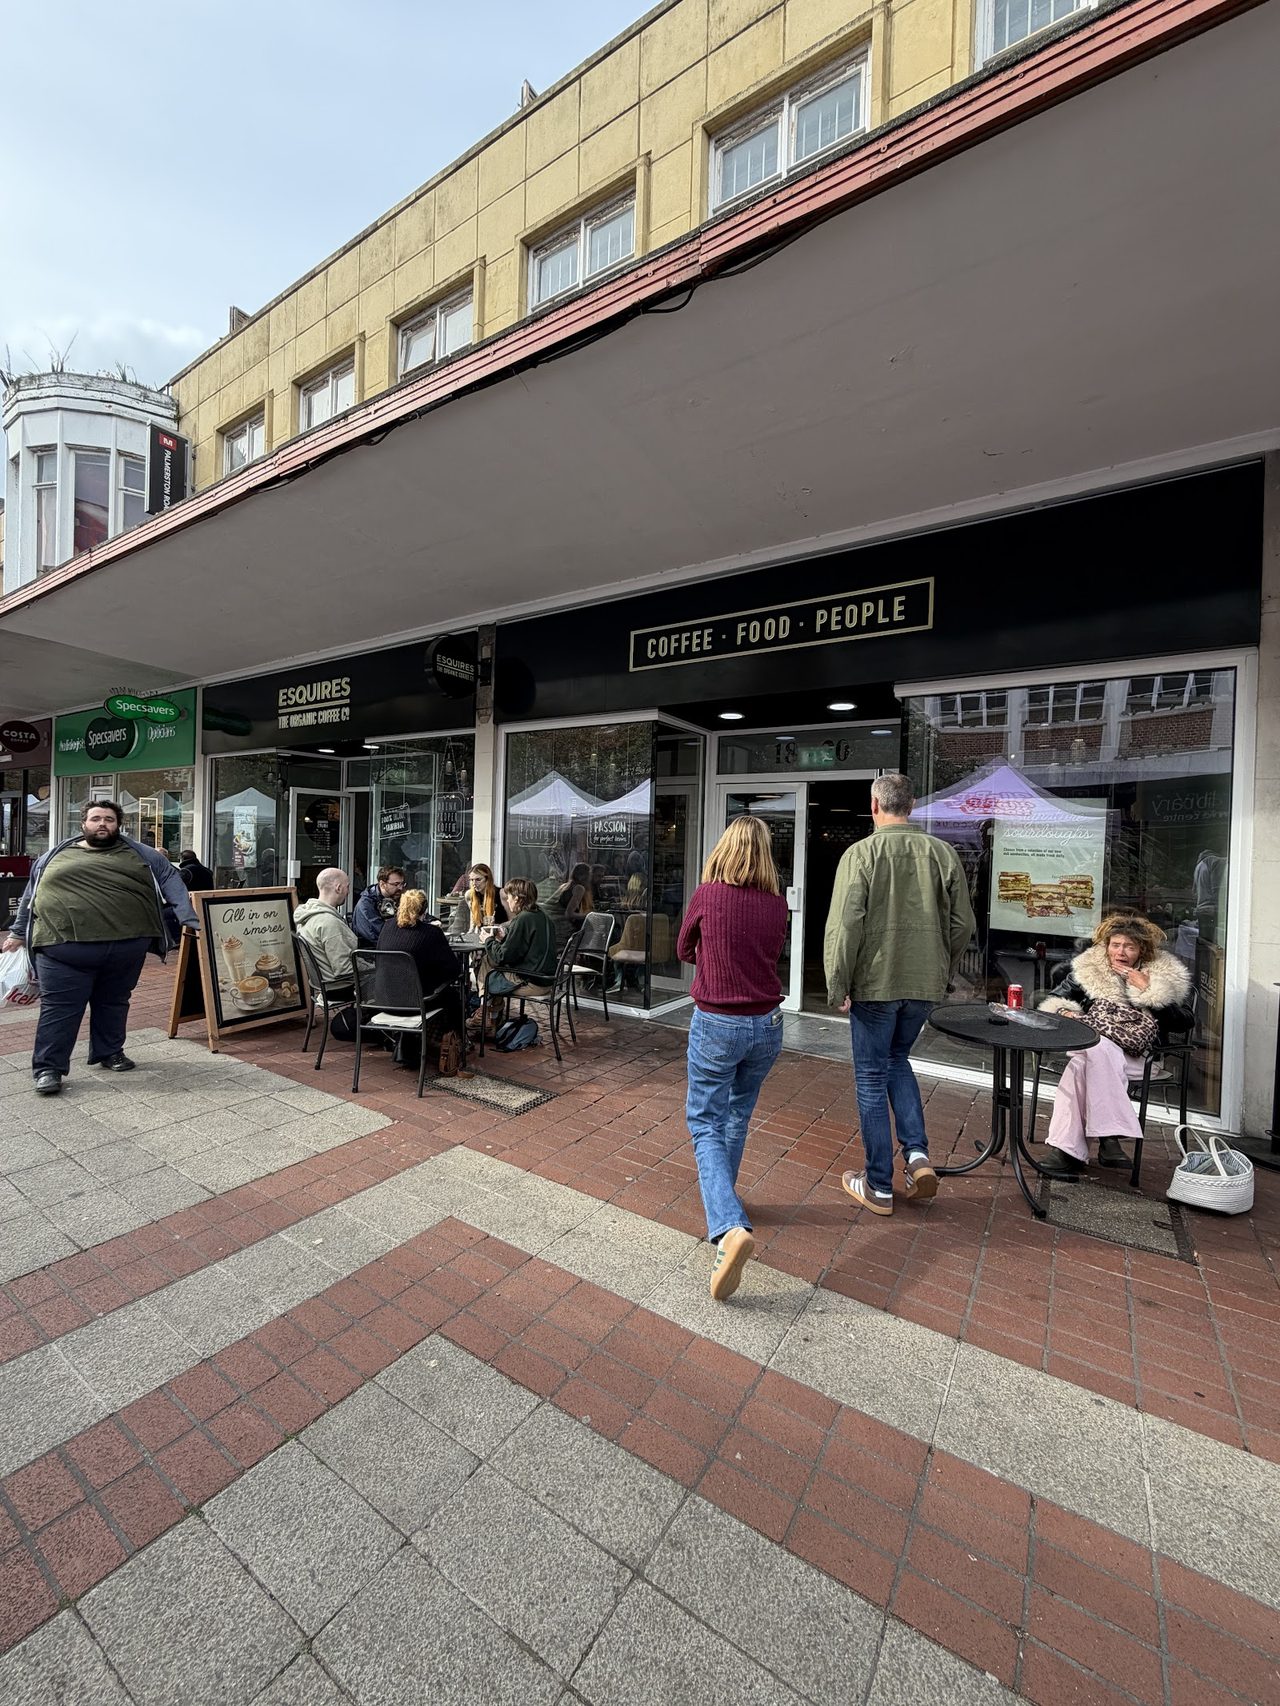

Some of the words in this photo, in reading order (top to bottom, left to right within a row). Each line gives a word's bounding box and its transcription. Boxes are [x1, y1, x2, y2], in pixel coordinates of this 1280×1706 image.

[163, 449, 172, 494] PALMERSTON
[163, 494, 171, 511] ROA
[647, 628, 713, 659] COFFEE
[736, 615, 790, 646] FOOD
[815, 595, 906, 633] PEOPLE
[437, 654, 475, 673] ESQUIRES
[278, 677, 351, 707] ESQUIRES
[115, 699, 175, 716] Specsavers
[278, 715, 289, 729] THE
[289, 711, 318, 728] ORGANIC
[317, 708, 341, 725] COFFEE
[2, 730, 36, 740] COSTA
[88, 728, 127, 749] Specsavers
[594, 820, 627, 833] PASSION
[1003, 823, 1094, 847] sourdoughs
[222, 908, 245, 923] All
[248, 909, 260, 920] in
[263, 910, 279, 919] on
[243, 921, 285, 936] s'mores
